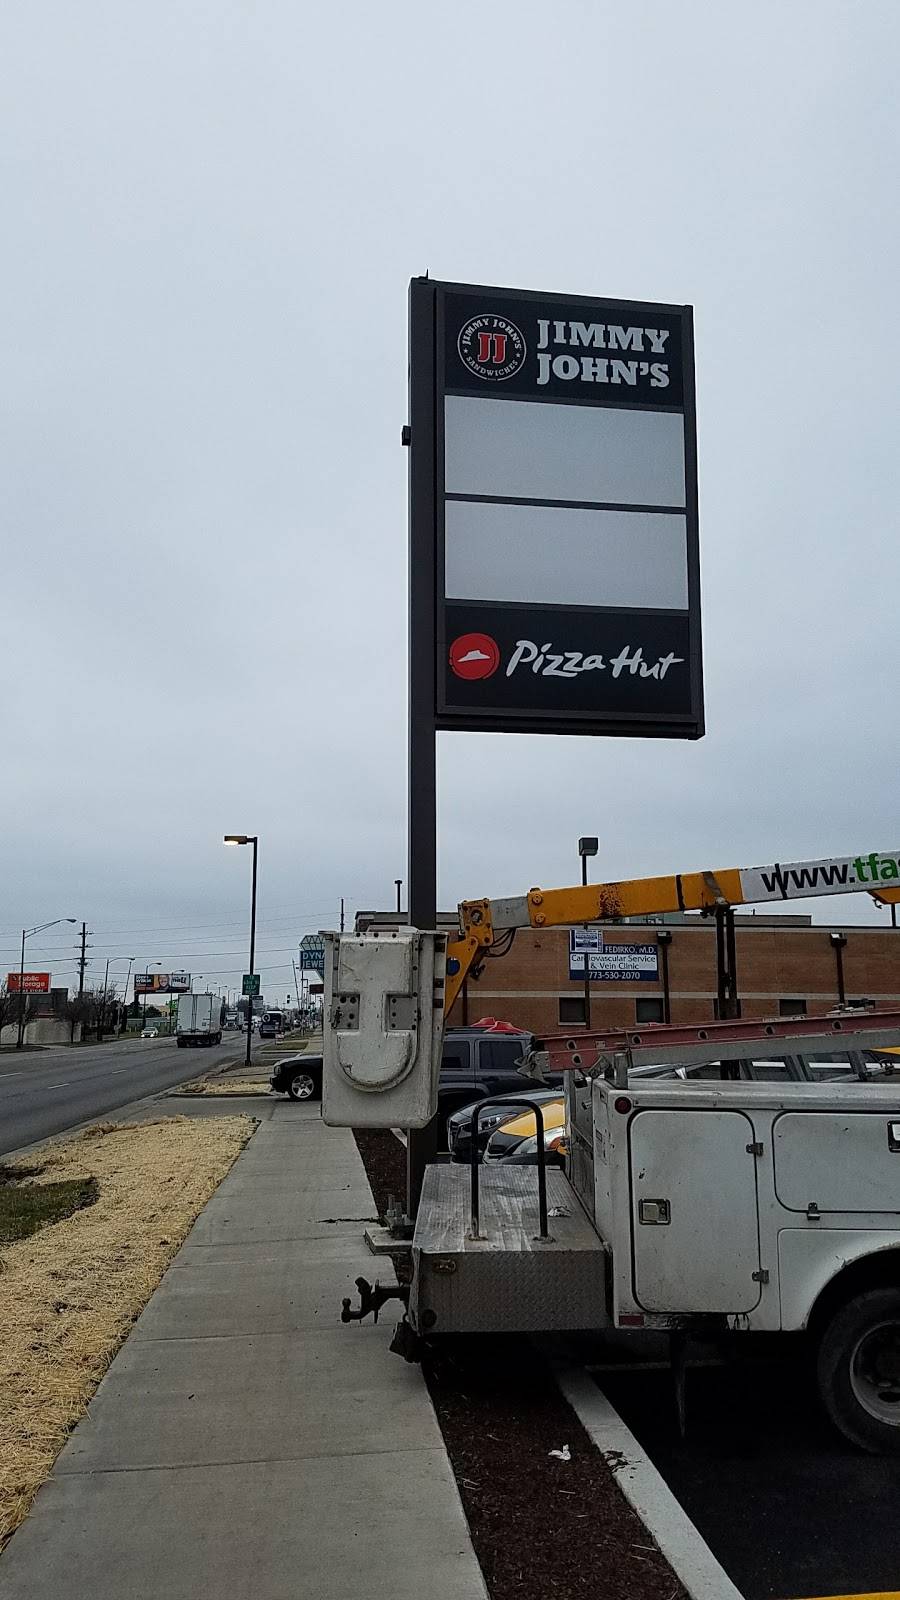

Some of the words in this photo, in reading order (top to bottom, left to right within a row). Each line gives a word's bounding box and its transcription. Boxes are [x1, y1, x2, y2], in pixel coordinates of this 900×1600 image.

[462, 318, 489, 345] JIMMY
[493, 319, 522, 350] JOHN'S
[477, 332, 508, 364] JJ
[537, 319, 670, 354] JIMMY
[466, 356, 519, 376] SANDWICHES
[537, 353, 670, 388] JOHN'S
[506, 640, 606, 678] Pizza
[609, 645, 685, 680] Hut
[618, 962, 640, 970] Clinic
[627, 954, 656, 962] Service
[588, 971, 641, 979] 773-530-2070
